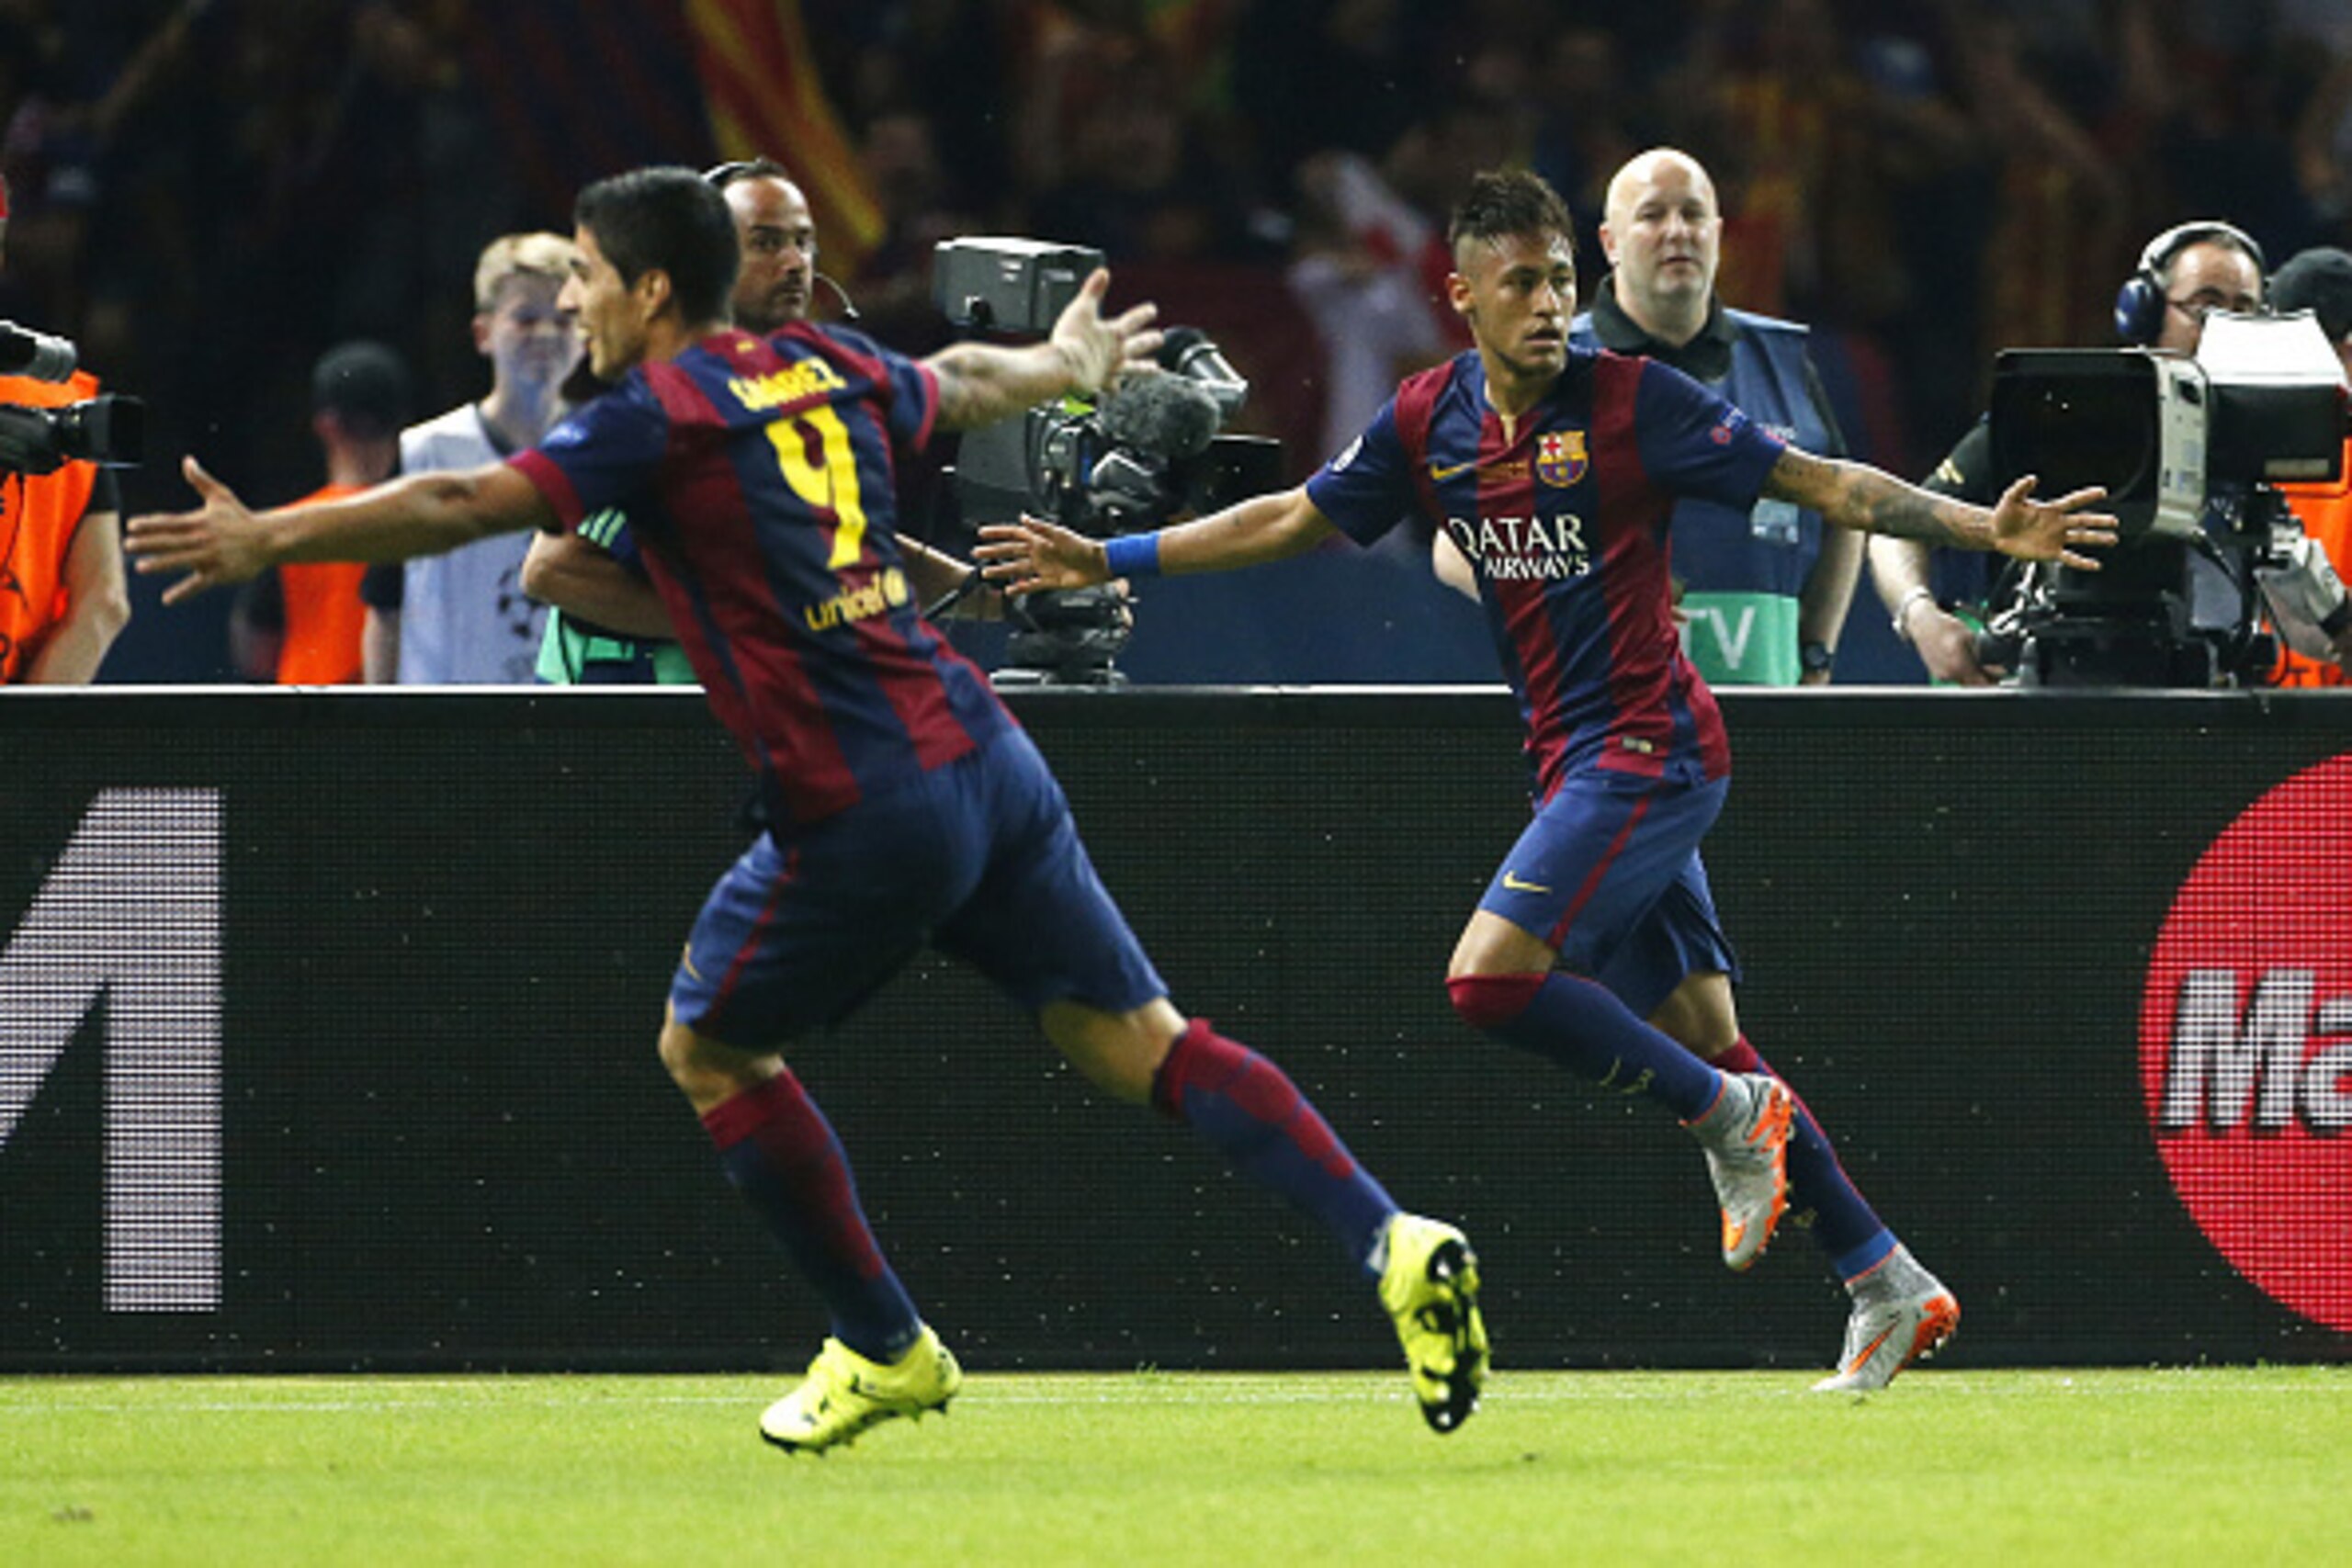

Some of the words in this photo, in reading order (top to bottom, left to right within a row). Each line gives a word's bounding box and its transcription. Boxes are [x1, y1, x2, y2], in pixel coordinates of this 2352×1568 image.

[765, 403, 867, 570] 9
[1448, 513, 1588, 560] QATAR
[1485, 553, 1591, 580] AIRWAYS
[1673, 606, 1755, 671] TV
